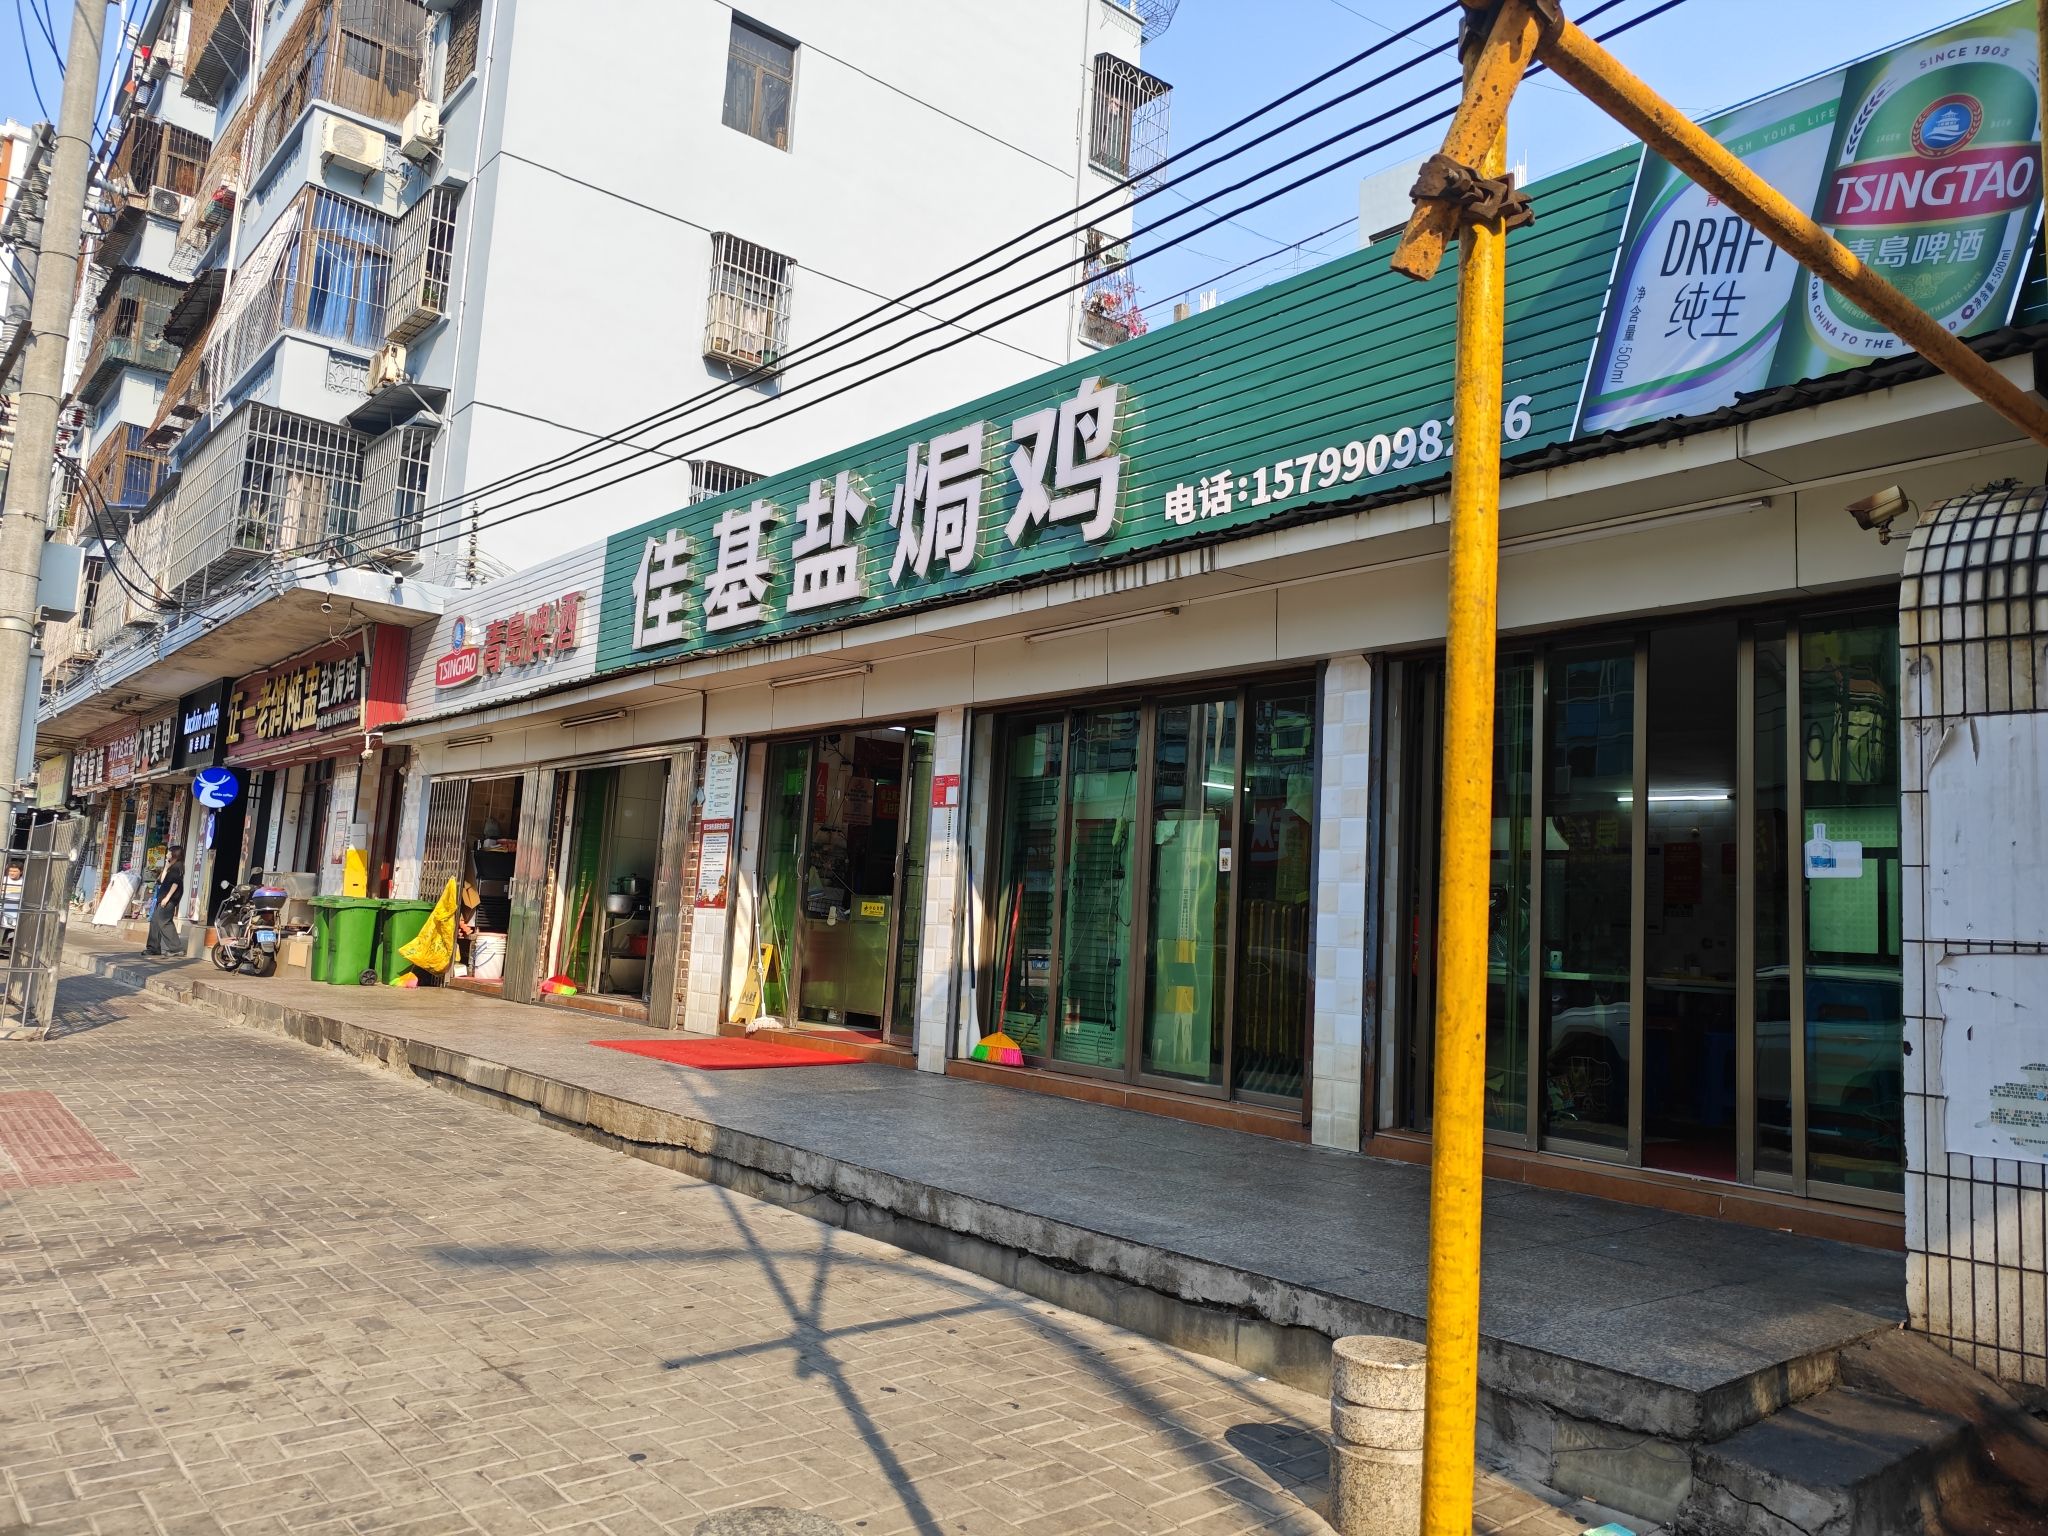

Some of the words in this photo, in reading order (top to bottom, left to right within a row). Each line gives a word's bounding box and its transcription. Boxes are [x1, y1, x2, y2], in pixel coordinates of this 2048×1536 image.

[1919, 46, 1968, 70] SINCE
[1974, 45, 2011, 58] 1903
[1763, 123, 1796, 143] YOUR
[1807, 107, 1836, 126] LIFE
[1835, 156, 2035, 215] TSINGTAO
[1848, 228, 1987, 268] 青岛啤酒
[1664, 280, 1746, 341] 纯生
[1813, 304, 1838, 337] CHINA
[1841, 332, 1858, 345] TO
[1865, 338, 1895, 349] THE
[1164, 394, 1533, 525] 电话:157990986
[631, 376, 1127, 650] 佳基盐焗鸡
[483, 590, 584, 673] 青岛啤酒
[439, 652, 477, 681] TSINGTAO
